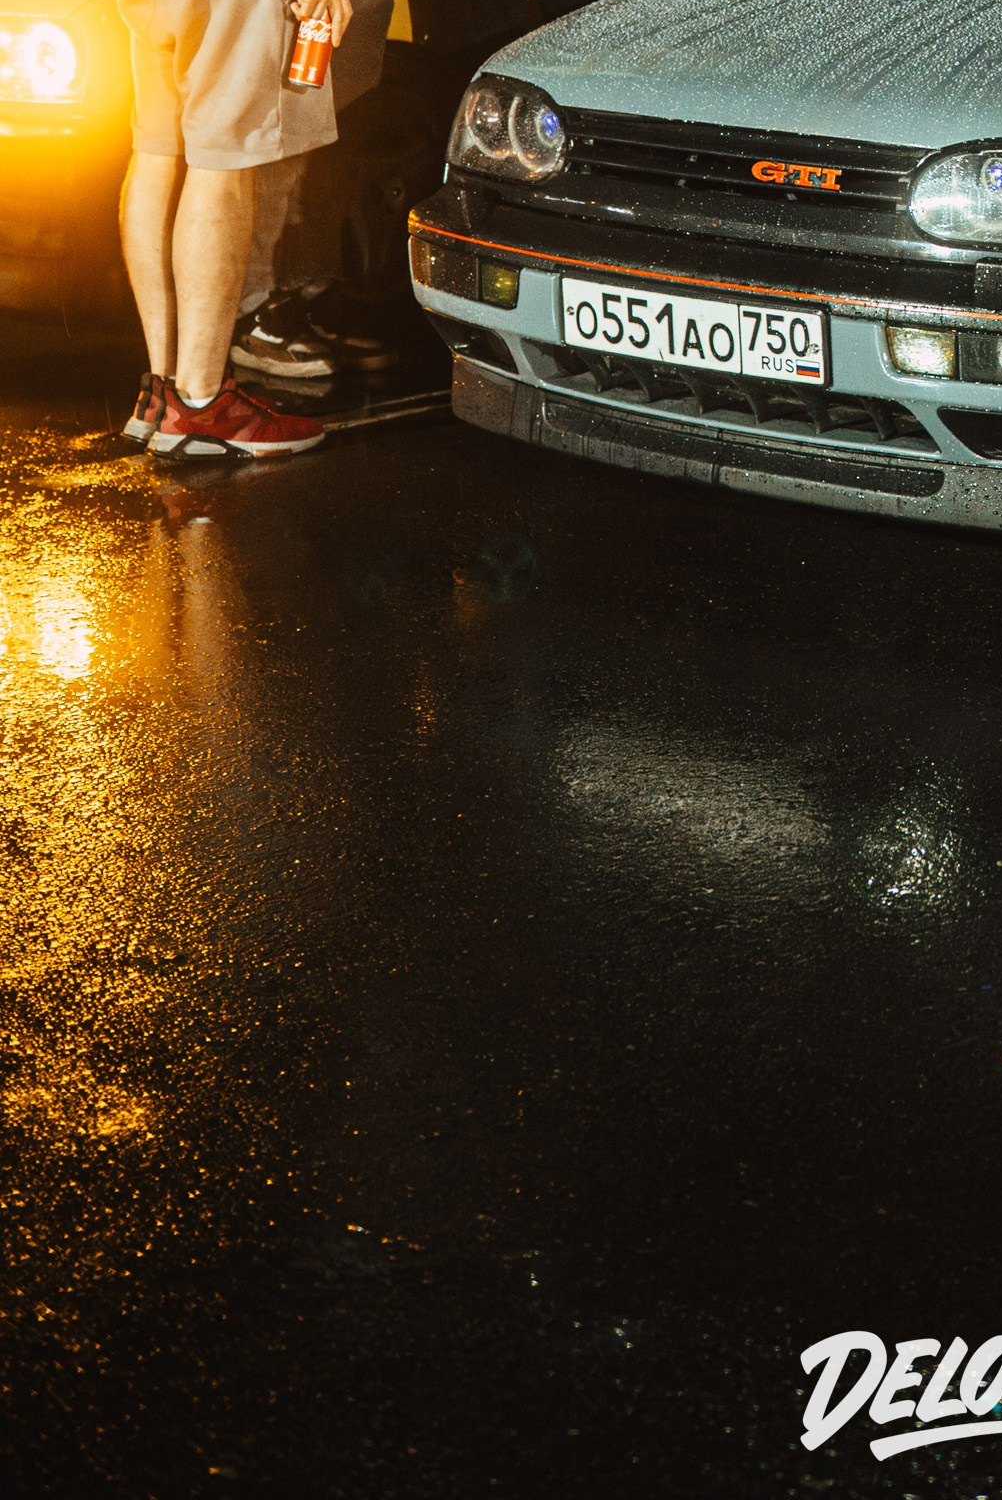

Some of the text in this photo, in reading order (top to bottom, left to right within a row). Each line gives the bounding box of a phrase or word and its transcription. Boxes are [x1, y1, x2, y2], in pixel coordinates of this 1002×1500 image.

[751, 161, 842, 190] GTI
[743, 310, 810, 358] 750
[761, 355, 794, 373] RUS
